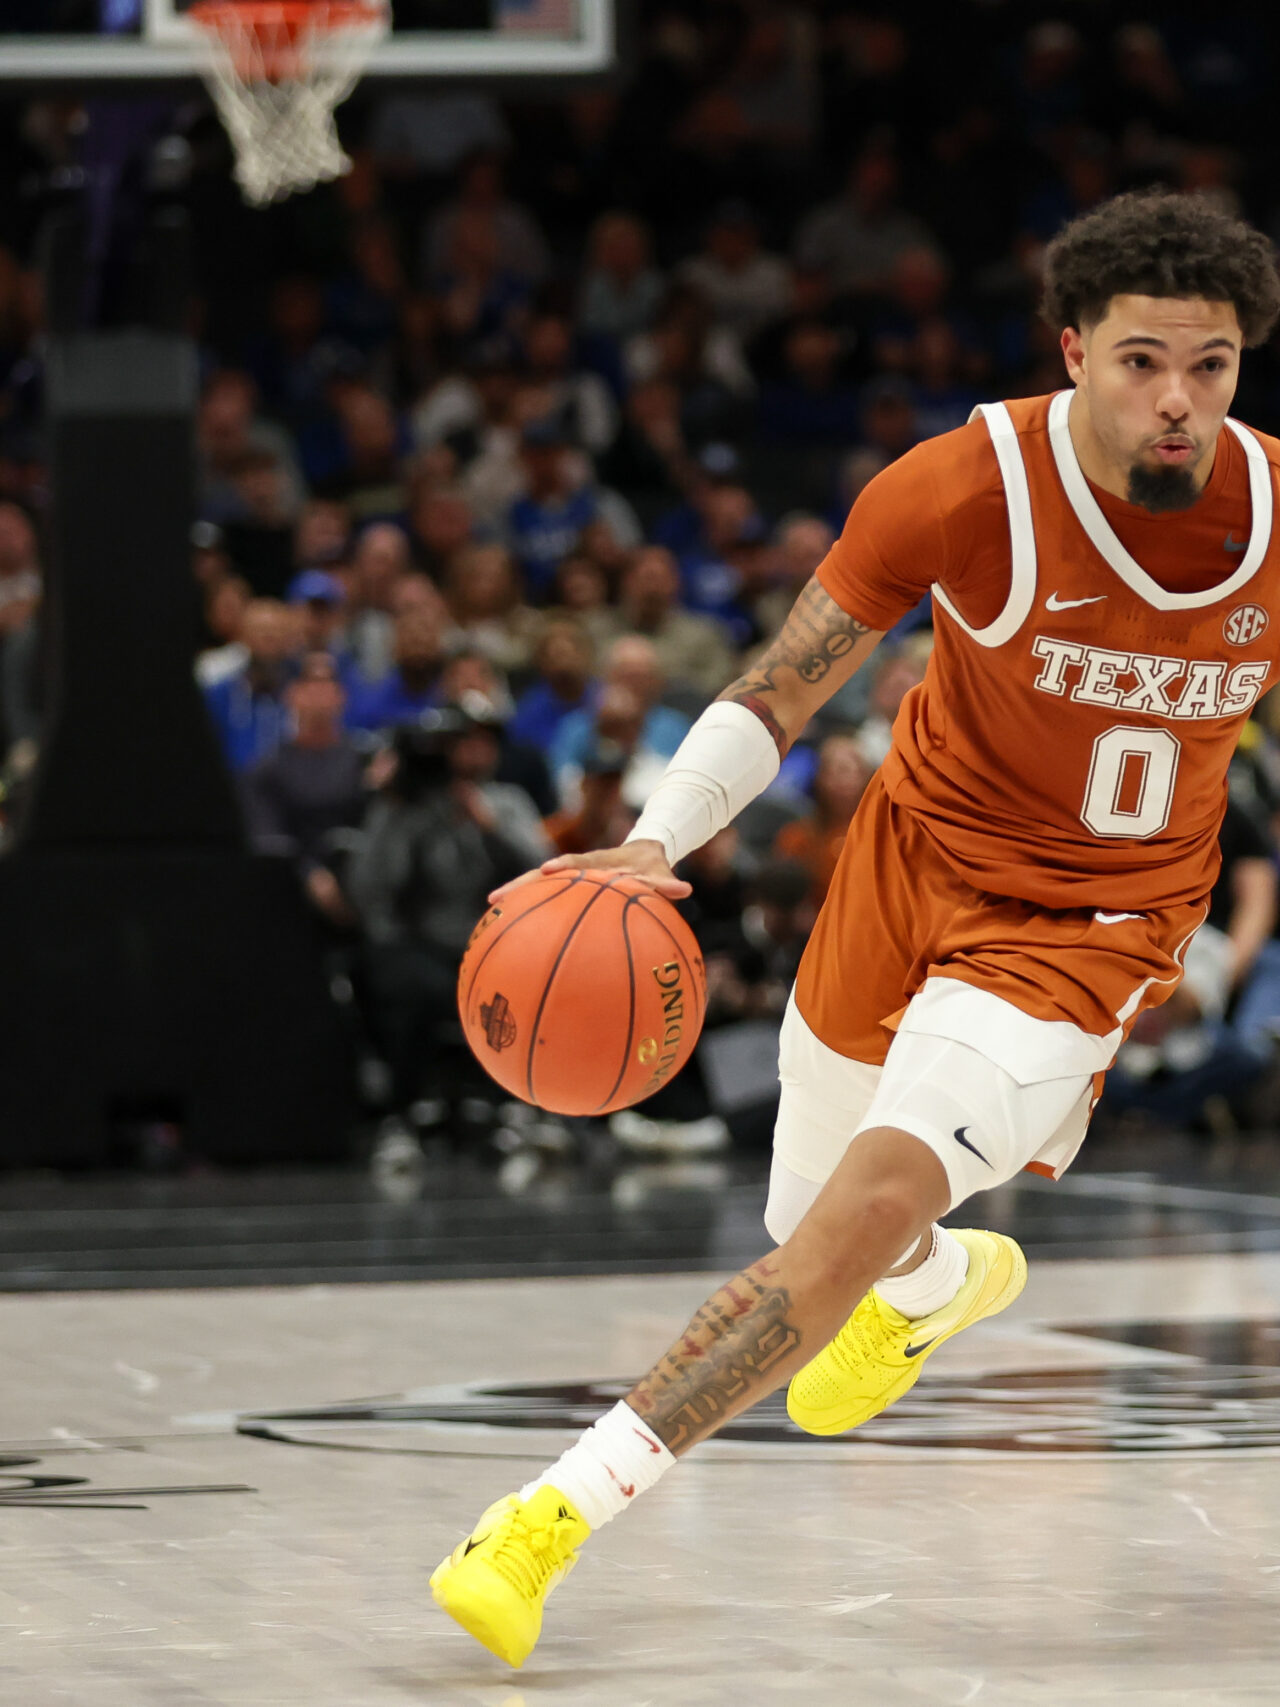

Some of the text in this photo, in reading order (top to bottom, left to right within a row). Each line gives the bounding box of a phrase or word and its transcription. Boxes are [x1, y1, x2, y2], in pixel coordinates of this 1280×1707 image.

[1227, 606, 1266, 644] SEC
[1031, 635, 1271, 720] TEXAS
[1080, 725, 1181, 839] 0
